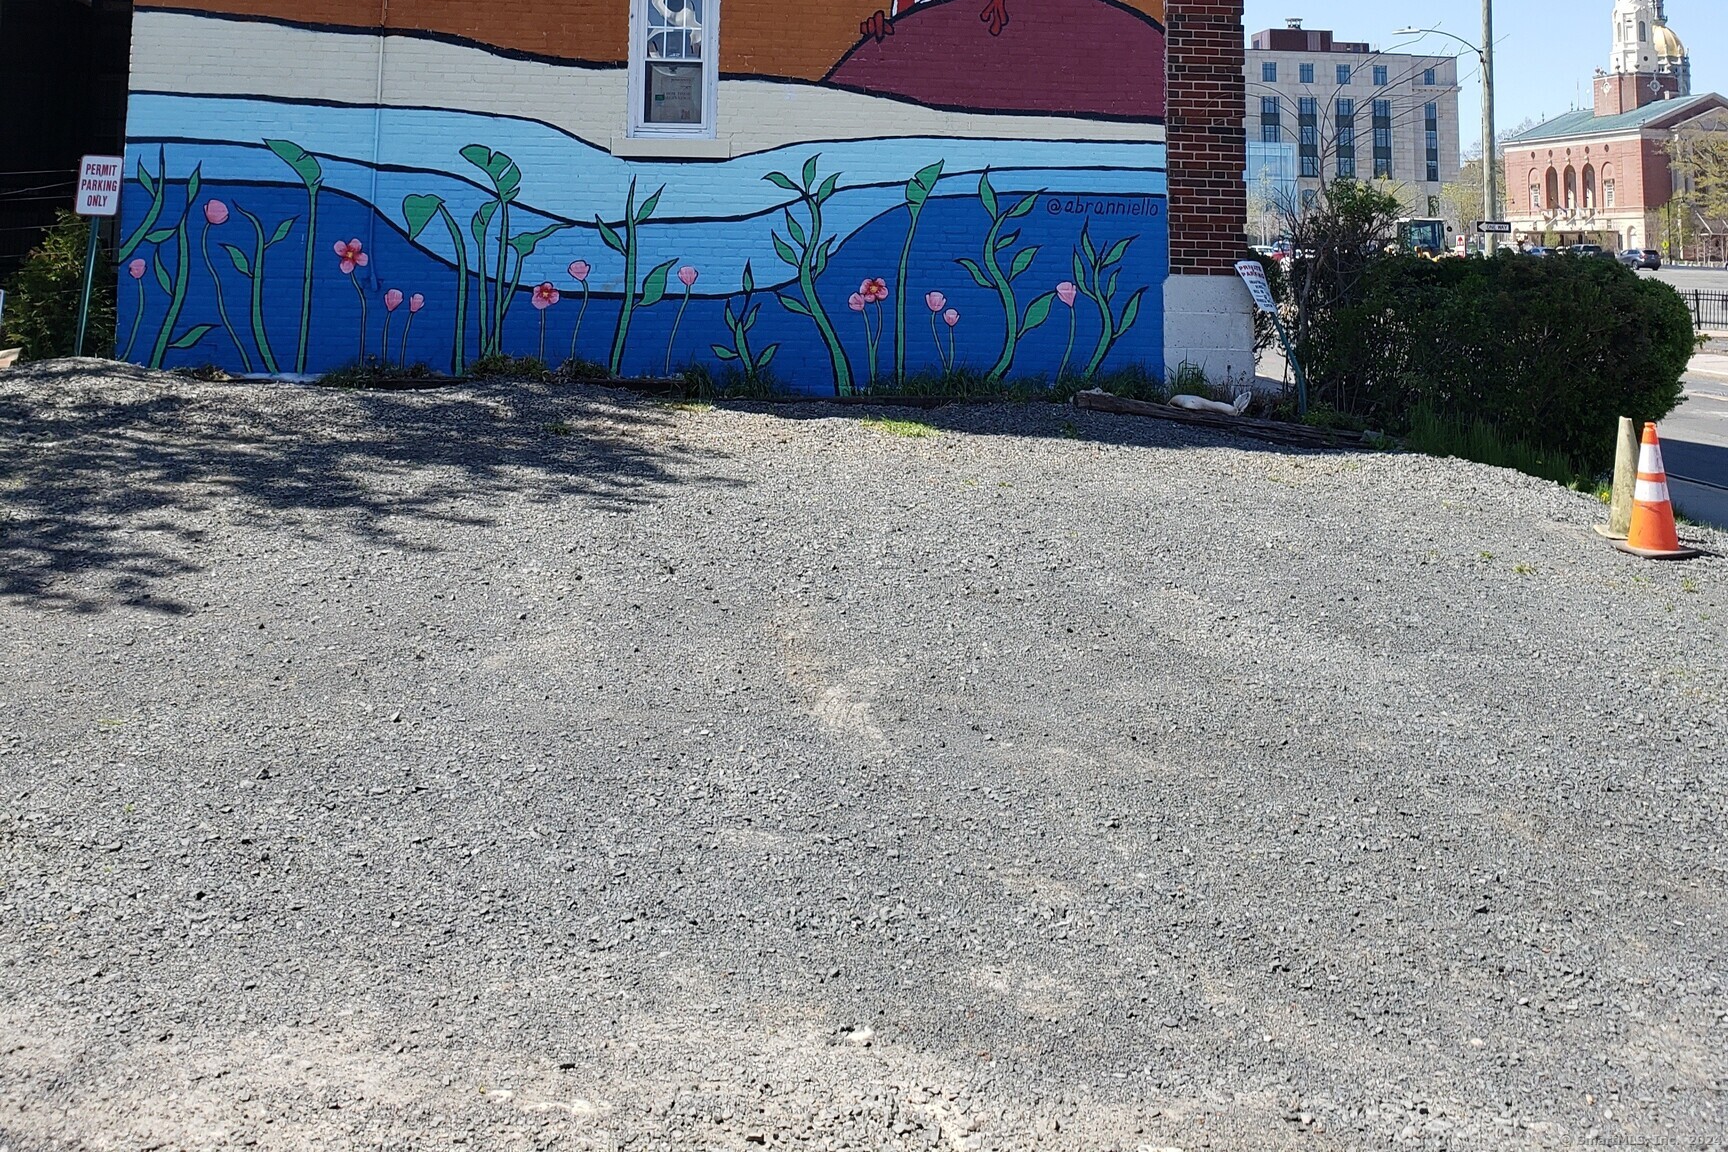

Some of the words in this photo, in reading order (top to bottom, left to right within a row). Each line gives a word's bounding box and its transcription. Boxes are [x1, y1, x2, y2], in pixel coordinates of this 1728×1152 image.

[85, 163, 118, 176] PERMIT
[81, 179, 118, 192] PARKING
[86, 194, 108, 207] ONLY
[1046, 196, 1159, 217] @abranniello
